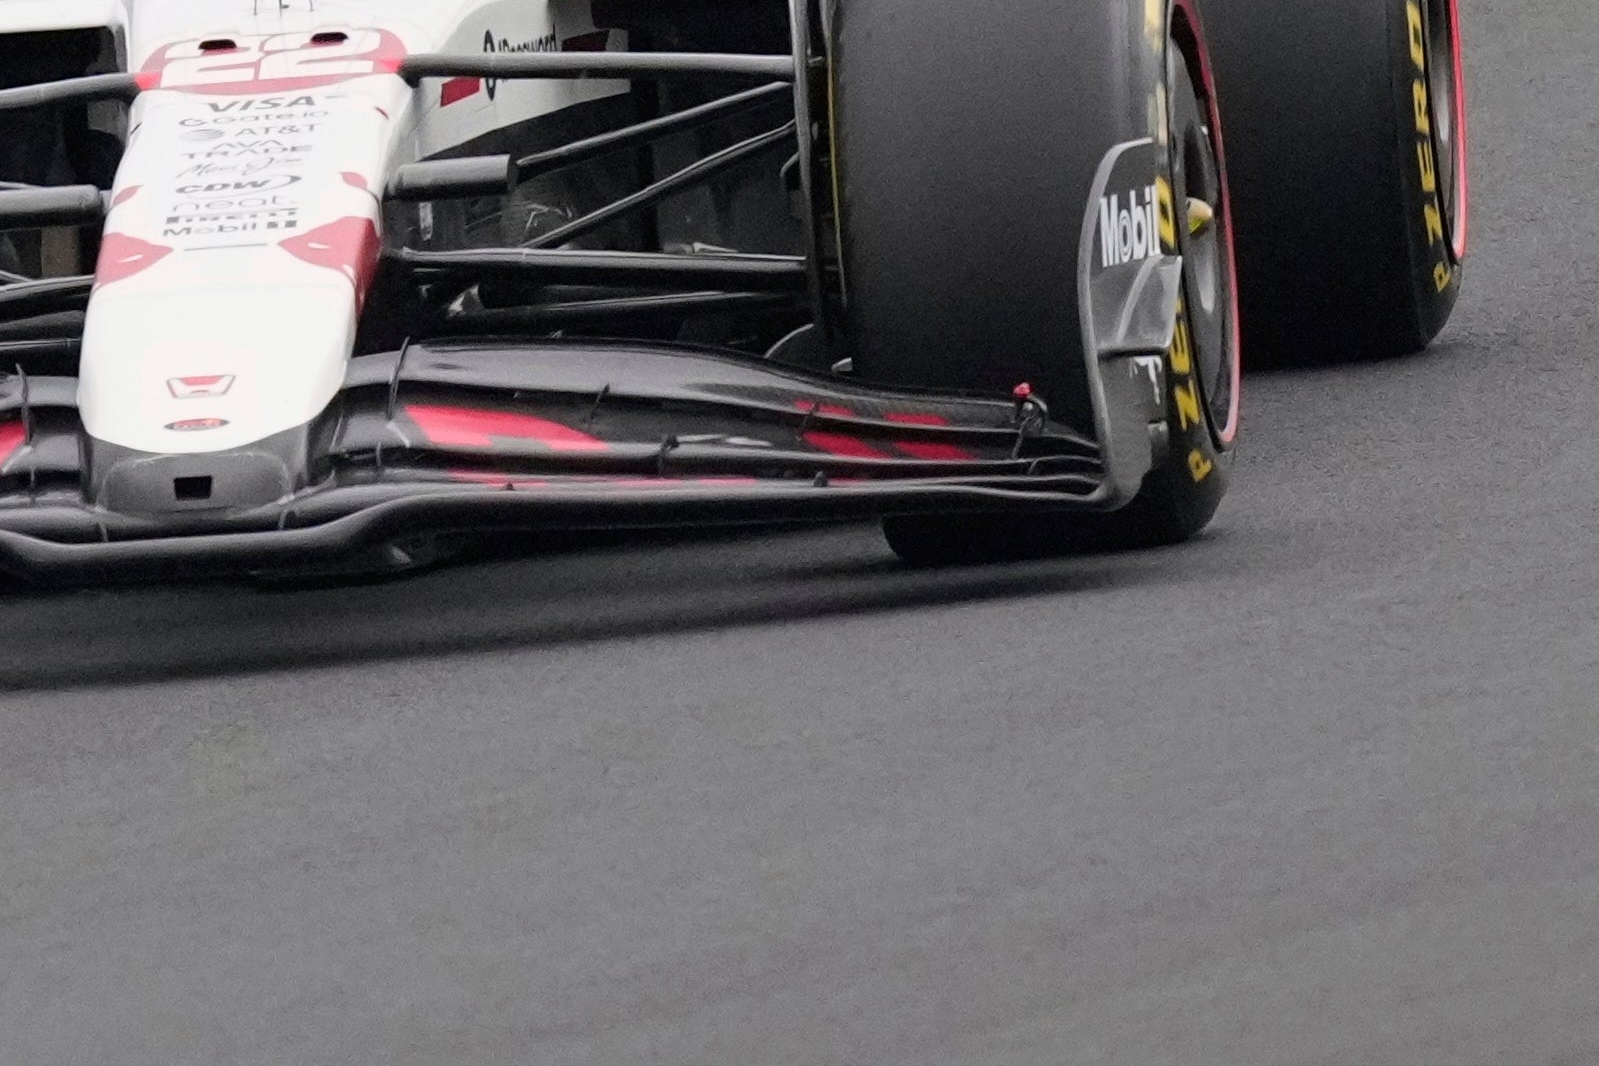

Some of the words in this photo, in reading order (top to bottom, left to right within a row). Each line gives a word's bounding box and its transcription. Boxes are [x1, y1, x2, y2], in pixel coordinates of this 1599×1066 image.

[136, 28, 407, 95] 22
[207, 95, 316, 112] VISA
[212, 111, 329, 125] Gate.io
[1406, 0, 1443, 246] ZERO
[235, 124, 322, 137] AT&T
[180, 144, 312, 159] TRADE
[176, 179, 273, 194] CDW
[163, 222, 257, 236] Mobil
[1100, 184, 1161, 269] Mobil
[1155, 175, 1201, 431] ZEO
